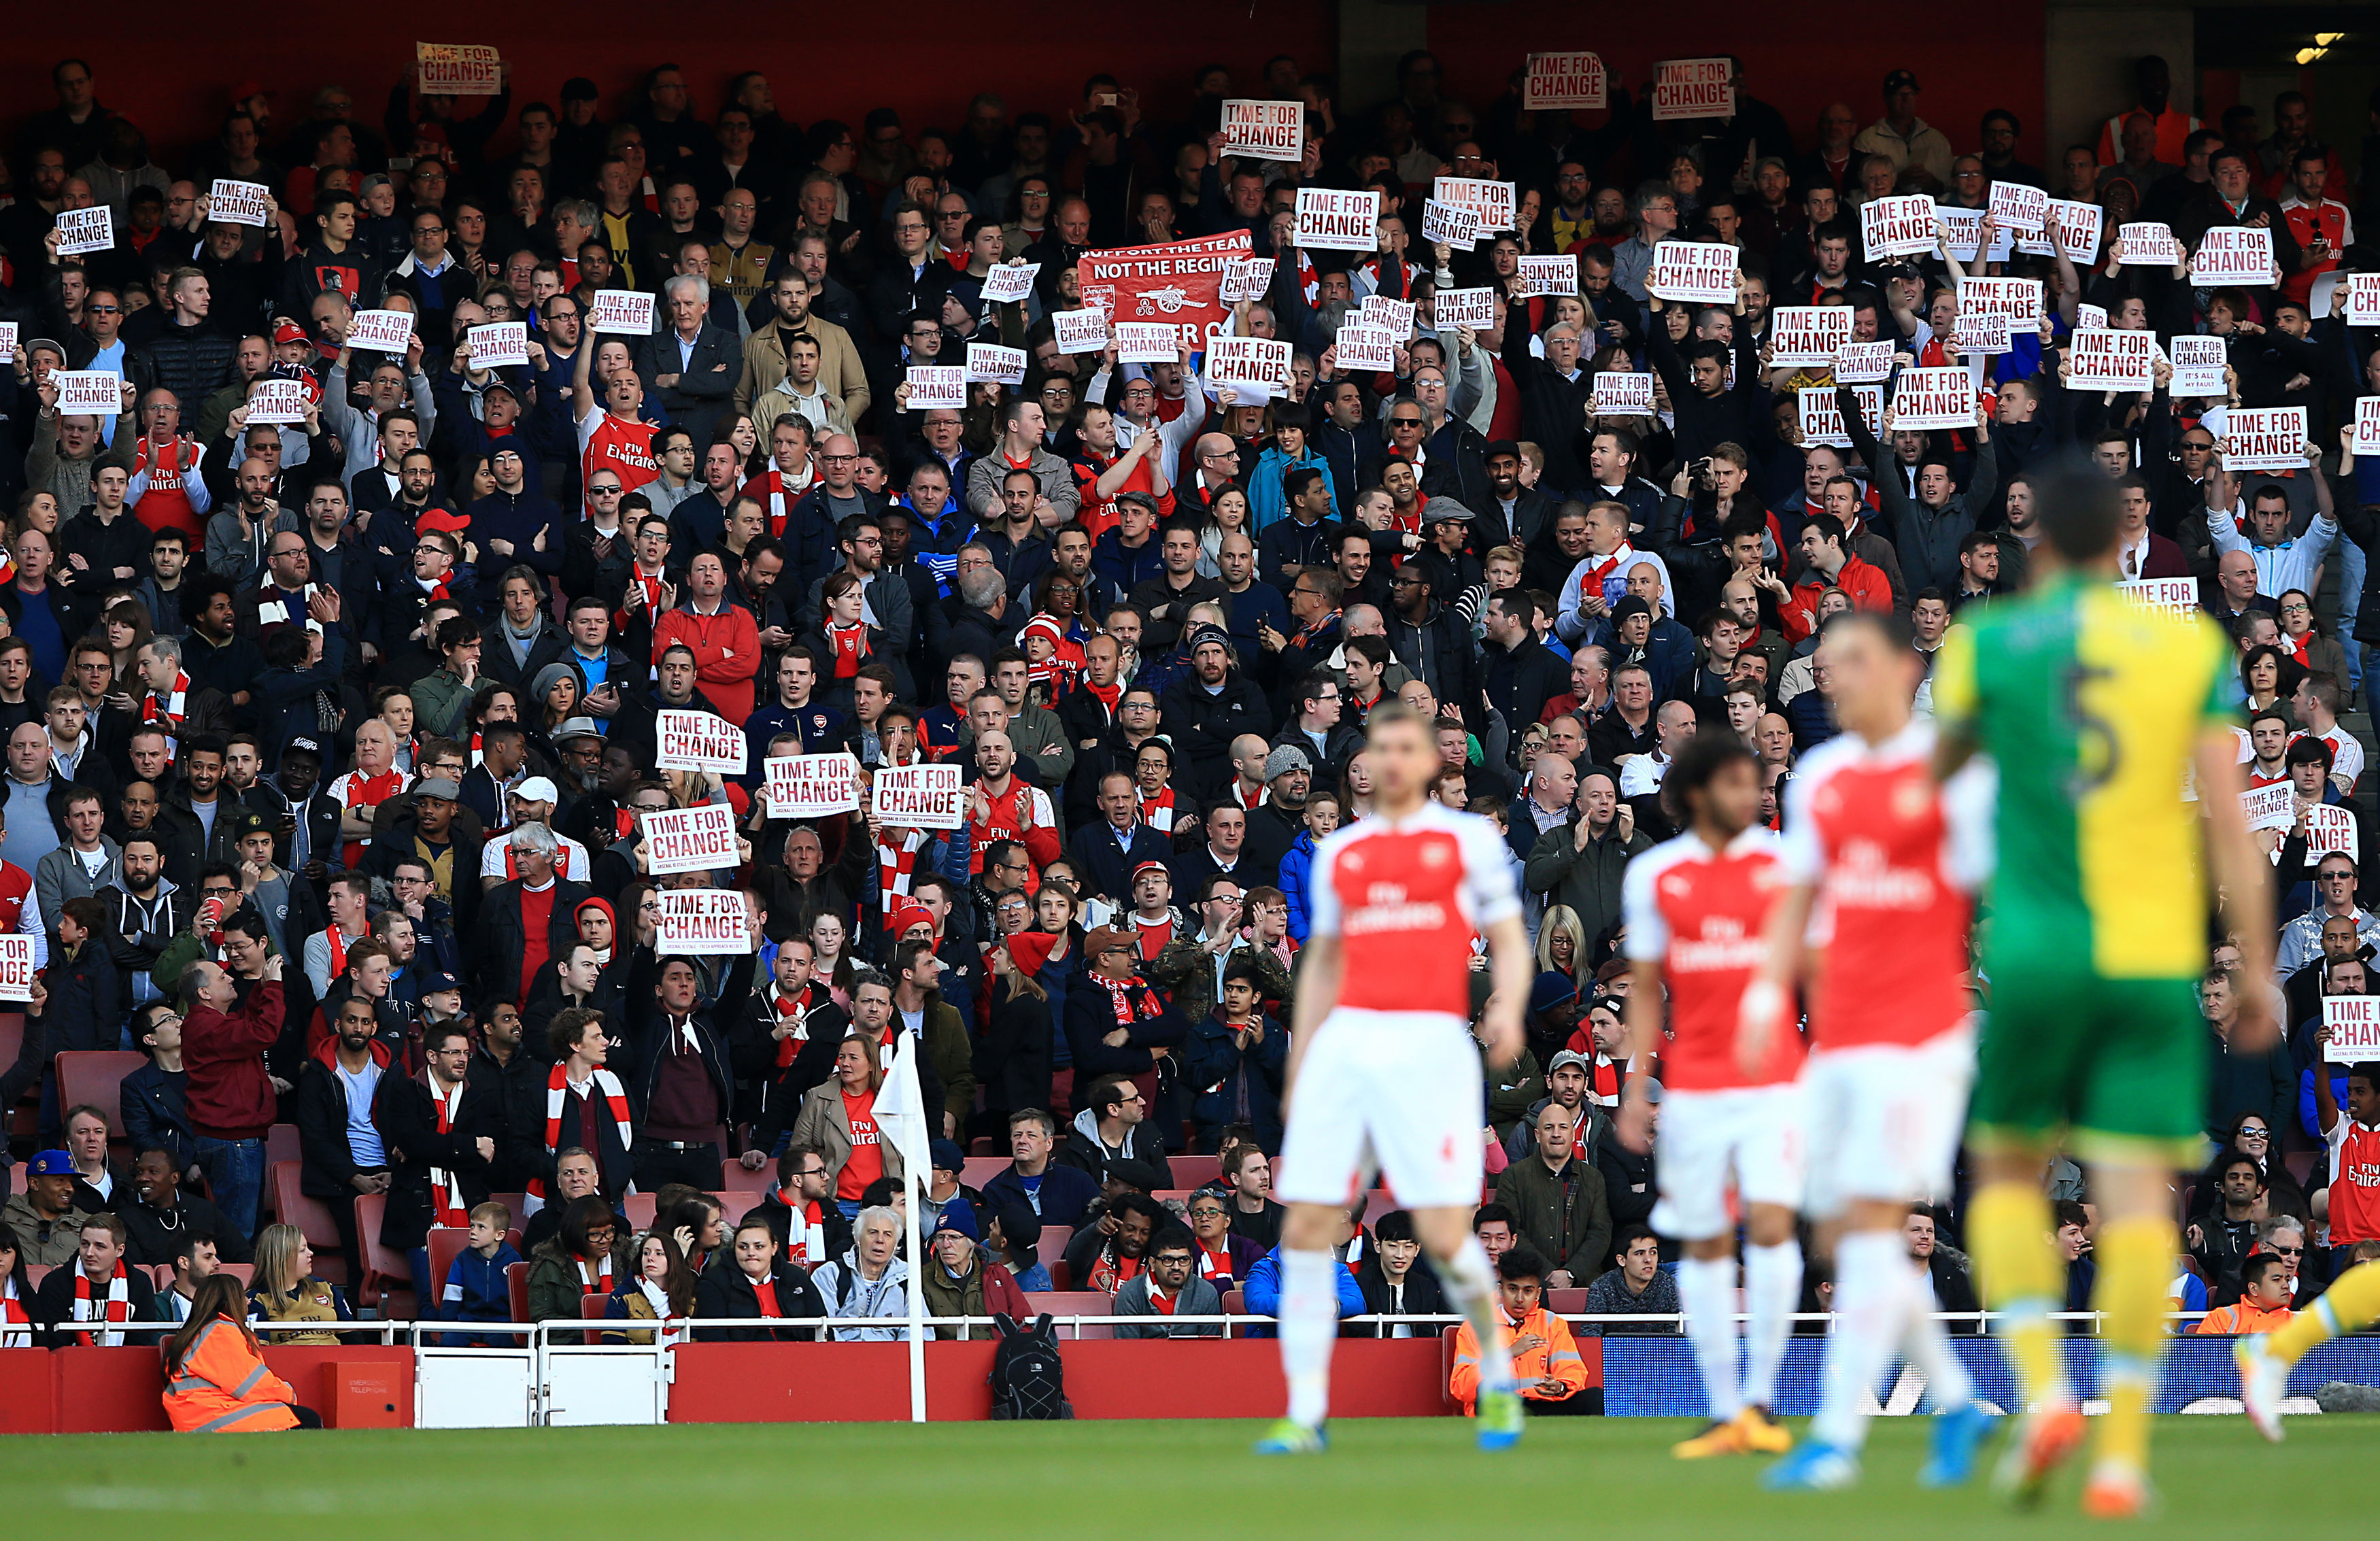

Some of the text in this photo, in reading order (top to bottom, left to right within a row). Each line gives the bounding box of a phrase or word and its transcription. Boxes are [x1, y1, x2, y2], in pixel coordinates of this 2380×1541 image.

[1532, 57, 1600, 75] TIME FOR
[1659, 63, 1727, 82] TIME FOR
[1531, 75, 1601, 97] CHANGE
[1658, 83, 1729, 105] CHANGE
[1227, 105, 1297, 124] TIME FOR
[1227, 124, 1296, 147] CHANGE
[216, 183, 265, 200] TIME FOR
[1995, 185, 2044, 205] TIME FOR
[214, 197, 263, 217] CHANGE
[1302, 193, 1372, 214] TIME FOR
[1865, 199, 1931, 224] TIME FOR
[1993, 200, 2043, 222] CHANGE
[58, 210, 107, 229] TIME FOR
[1425, 203, 1478, 226] TIME FOR
[61, 224, 109, 245] CHANGE
[1300, 213, 1372, 237] CHANGE
[1424, 217, 1477, 242] CHANGE
[1867, 218, 1935, 247] CHANGE
[1166, 243, 1202, 254] THE
[1204, 235, 1252, 250] TEAM
[2239, 233, 2265, 250] FOR
[1661, 246, 1732, 267] TIME FOR
[2196, 251, 2268, 272] CHANGE
[1093, 263, 1132, 280] NOT
[1135, 260, 1170, 277] THE
[1523, 265, 1573, 279] CHANGE
[1659, 266, 1732, 289] CHANGE
[1085, 285, 1112, 294] Arsenal
[1547, 281, 1573, 293] TIME
[597, 295, 650, 309] TIME FOR
[1436, 292, 1491, 307] TIME FOR
[597, 307, 649, 323] CHANGE
[1058, 315, 1103, 328] TIME FOR
[1436, 305, 1492, 322] CHANGE
[1777, 312, 1848, 330] TIME FOR
[1958, 316, 2006, 330] TIME FOR
[471, 328, 523, 343] TIME FOR
[1061, 327, 1104, 342] CHANGE
[1119, 327, 1147, 339] TIME
[1151, 328, 1172, 339] FOR
[1340, 330, 1391, 345] TIME FOR
[1957, 331, 2008, 346] CHANGE
[473, 341, 524, 358] CHANGE
[1121, 340, 1174, 352] CHANGE
[1213, 342, 1285, 360] TIME FOR
[1340, 343, 1391, 362] CHANGE
[1841, 345, 1891, 358] TIME FOR
[2077, 334, 2148, 354] TIME FOR
[2175, 341, 2222, 352] TIME FOR
[1839, 357, 1890, 373] CHANGE
[2074, 354, 2148, 377] CHANGE
[2176, 353, 2222, 365] CHANGE
[910, 369, 962, 382] TIME FOR
[1212, 359, 1284, 382] CHANGE
[65, 377, 90, 388] TIME
[95, 377, 115, 388] FOR
[911, 384, 963, 399] CHANGE
[1597, 375, 1648, 389] TIME FOR
[1899, 372, 1969, 392] TIME FOR
[65, 390, 116, 403] CHANGE
[1597, 390, 1649, 406] CHANGE
[1897, 393, 1970, 415] CHANGE
[2227, 413, 2301, 433] TIME FOR
[625, 443, 643, 455] Fly
[2229, 433, 2302, 456] CHANGE
[156, 469, 173, 478] Fly
[2160, 583, 2190, 603] FOR
[1059, 660, 1077, 669] Fly
[663, 715, 703, 735] TIME
[2063, 664, 2119, 793] 5
[292, 737, 318, 750] Kings
[664, 734, 741, 760] CHANGE
[771, 758, 849, 779] TIME FOR
[881, 770, 955, 789] TIME FOR
[773, 781, 851, 802] CHANGE
[879, 790, 957, 813] CHANGE
[648, 810, 728, 834] TIME FOR
[991, 828, 1010, 839] Fly
[653, 830, 731, 859] CHANGE
[664, 895, 741, 915] TIME FOR
[664, 916, 743, 939] CHANGE
[2330, 1002, 2372, 1020] TIME
[851, 1121, 871, 1132] Fly
[2362, 1163, 2380, 1174] Fly
